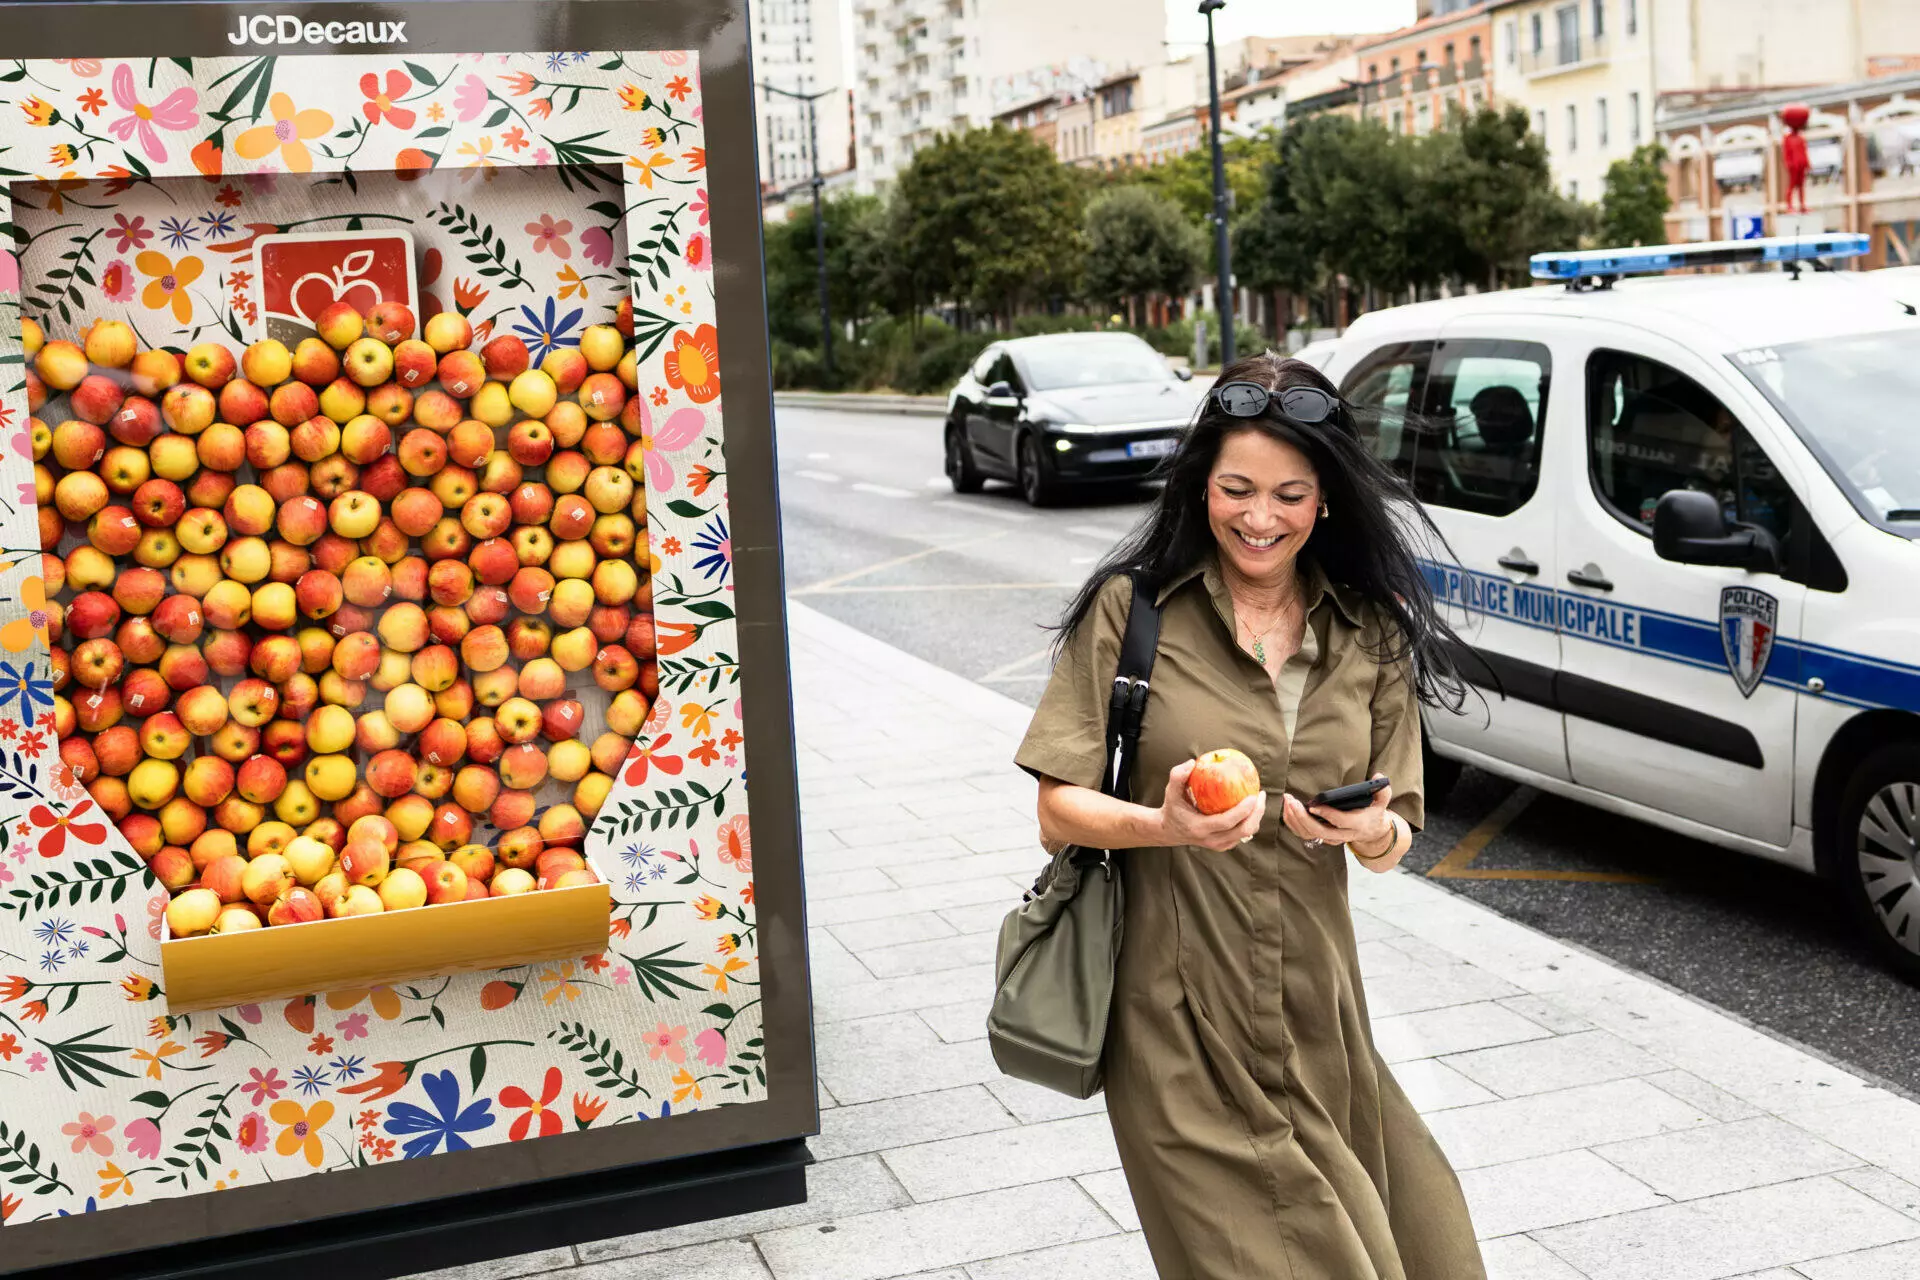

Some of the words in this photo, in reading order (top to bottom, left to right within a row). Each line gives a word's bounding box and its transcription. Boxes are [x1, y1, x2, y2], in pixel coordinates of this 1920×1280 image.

[227, 14, 409, 46] JCDecaux
[1450, 572, 1509, 614] POLICE
[1513, 587, 1636, 645] MUNICIPALE
[1724, 590, 1775, 614] POLICE
